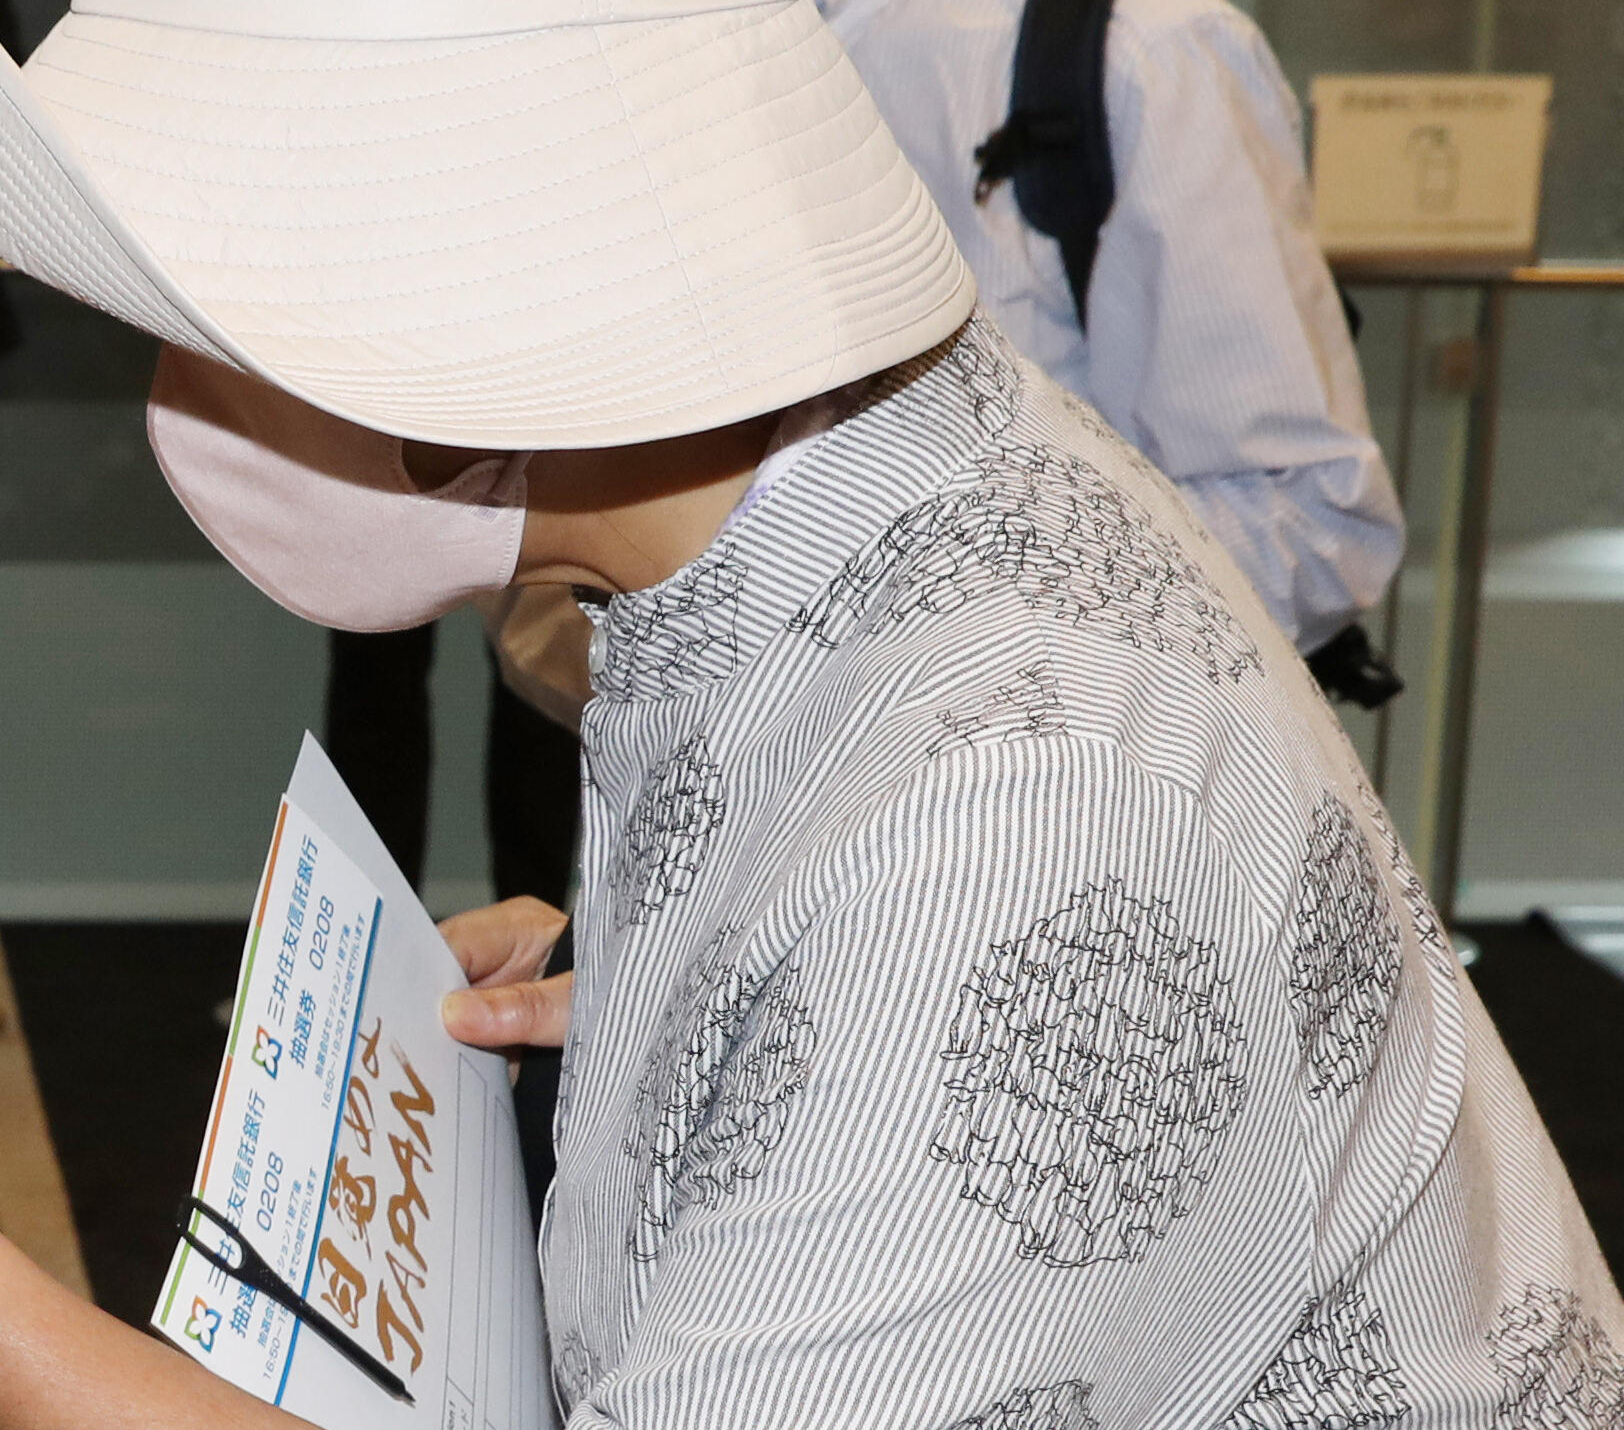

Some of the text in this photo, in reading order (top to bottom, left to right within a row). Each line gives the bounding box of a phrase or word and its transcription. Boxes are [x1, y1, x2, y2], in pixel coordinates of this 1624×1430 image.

[267, 835, 318, 1027] 三井住友信託銀行
[290, 896, 335, 1070] 抽選券 0208
[257, 1152, 284, 1232] 0208
[377, 1039, 435, 1373] JAPAN
